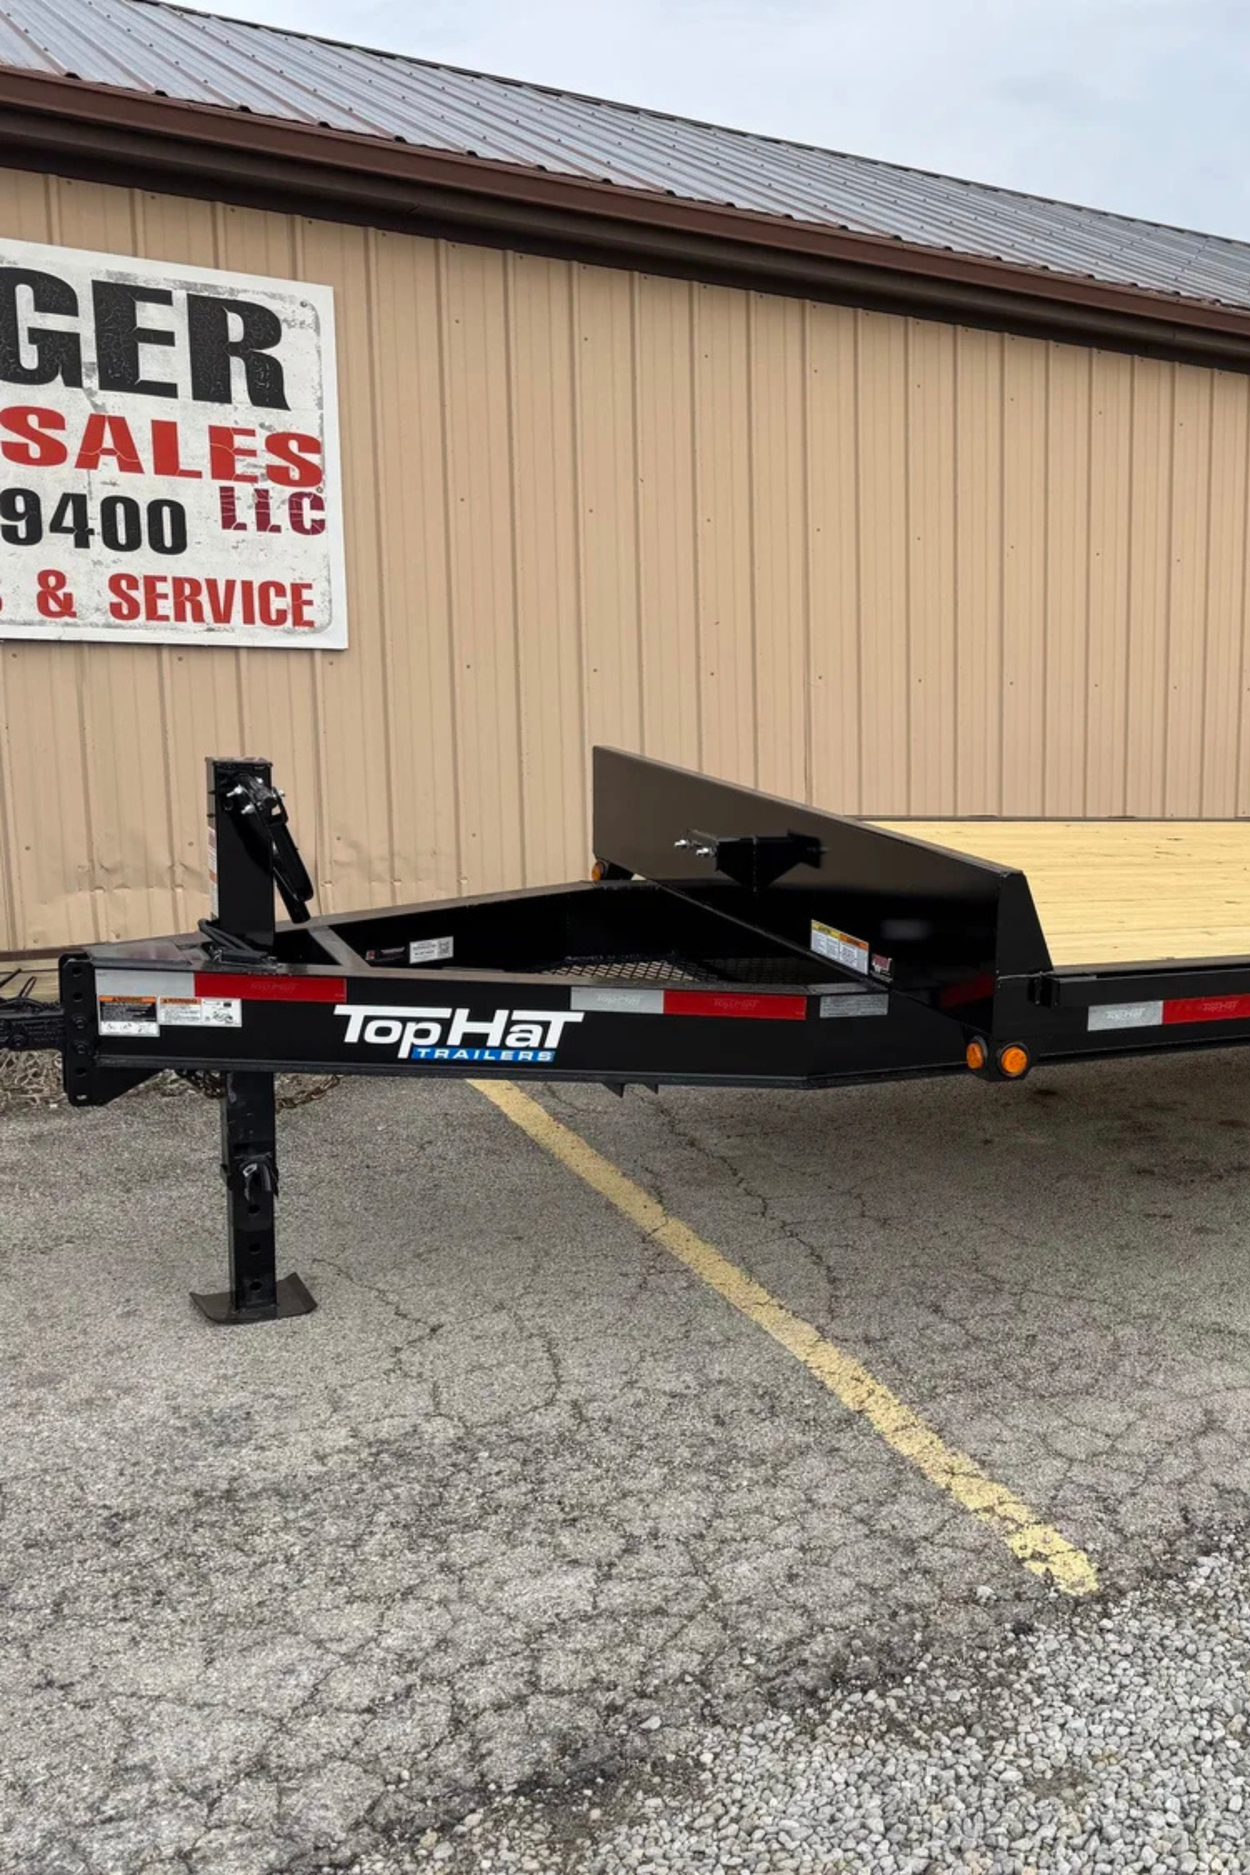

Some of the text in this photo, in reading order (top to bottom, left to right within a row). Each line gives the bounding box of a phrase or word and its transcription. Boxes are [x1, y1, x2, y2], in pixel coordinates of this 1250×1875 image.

[0, 267, 291, 411] GER
[0, 406, 323, 487] SALES
[0, 487, 188, 555] 9400
[220, 486, 326, 535] LLC
[36, 569, 77, 618] &
[108, 573, 315, 628] SERVICE
[418, 1049, 553, 1062] TRAILERS
